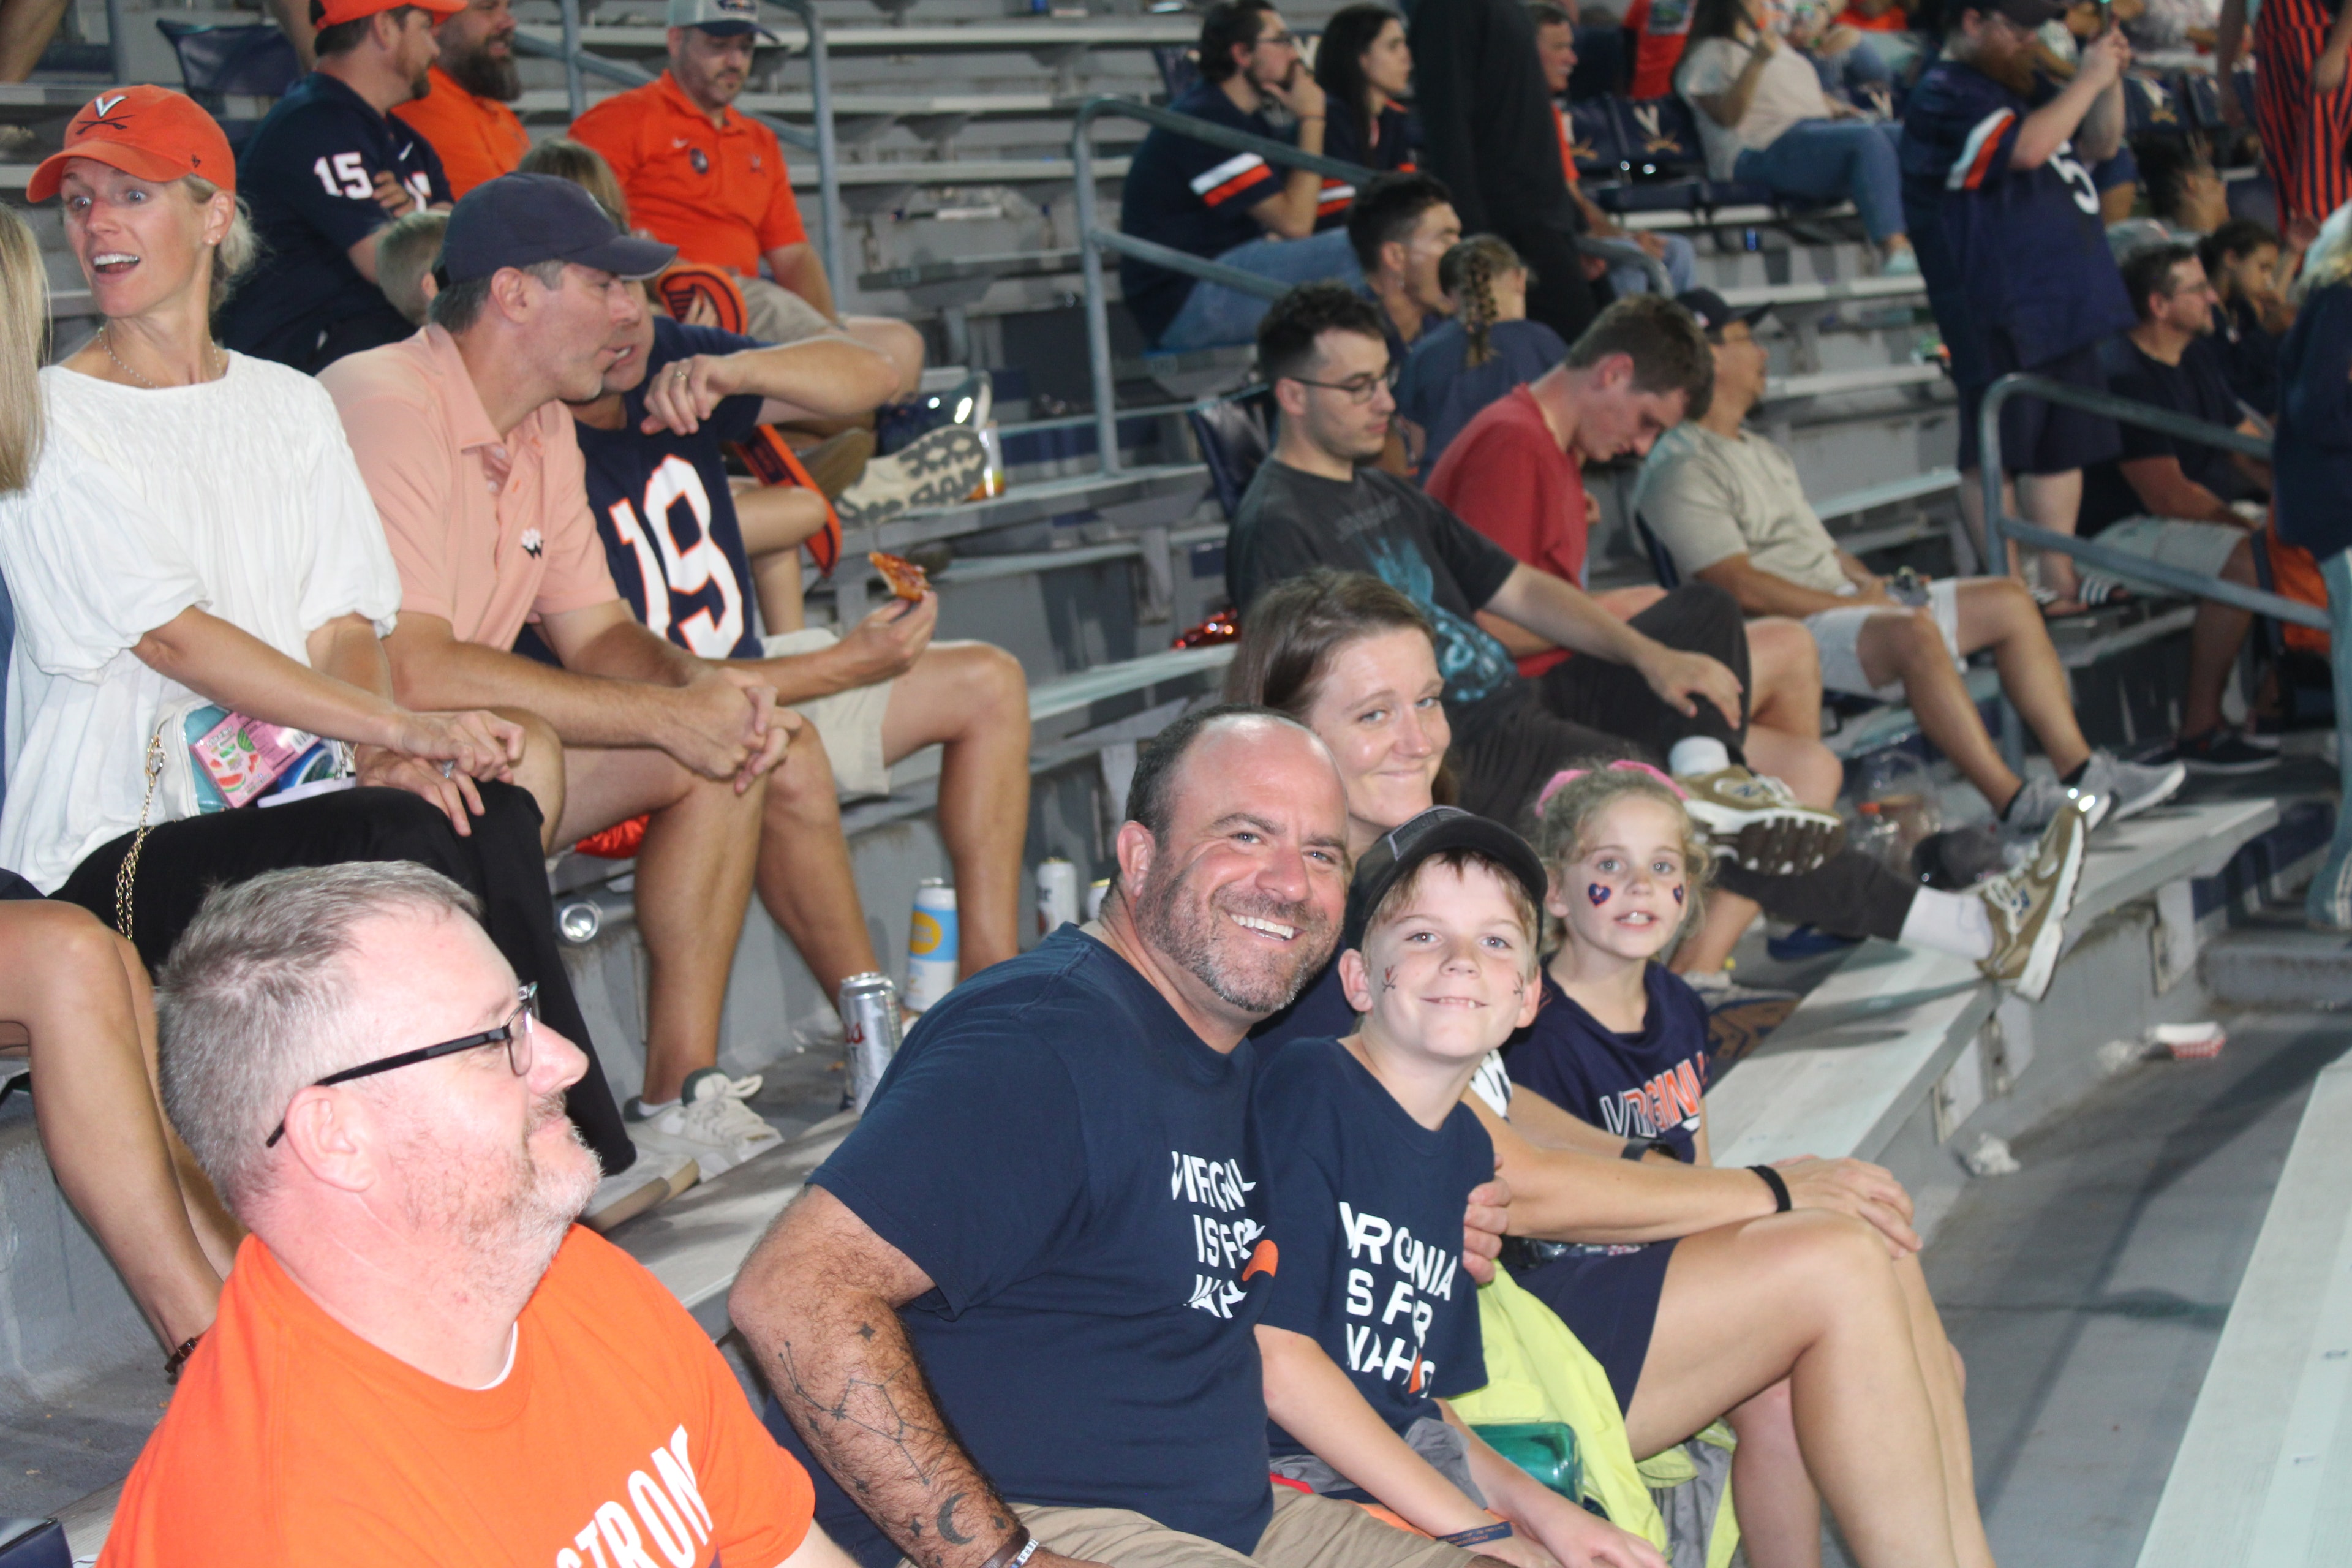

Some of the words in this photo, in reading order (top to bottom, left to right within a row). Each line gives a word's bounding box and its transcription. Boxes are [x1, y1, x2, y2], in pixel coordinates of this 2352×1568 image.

[314, 151, 374, 200] 15
[608, 453, 744, 660] 19
[1346, 1267, 1374, 1317] S
[1382, 1280, 1433, 1349] FR
